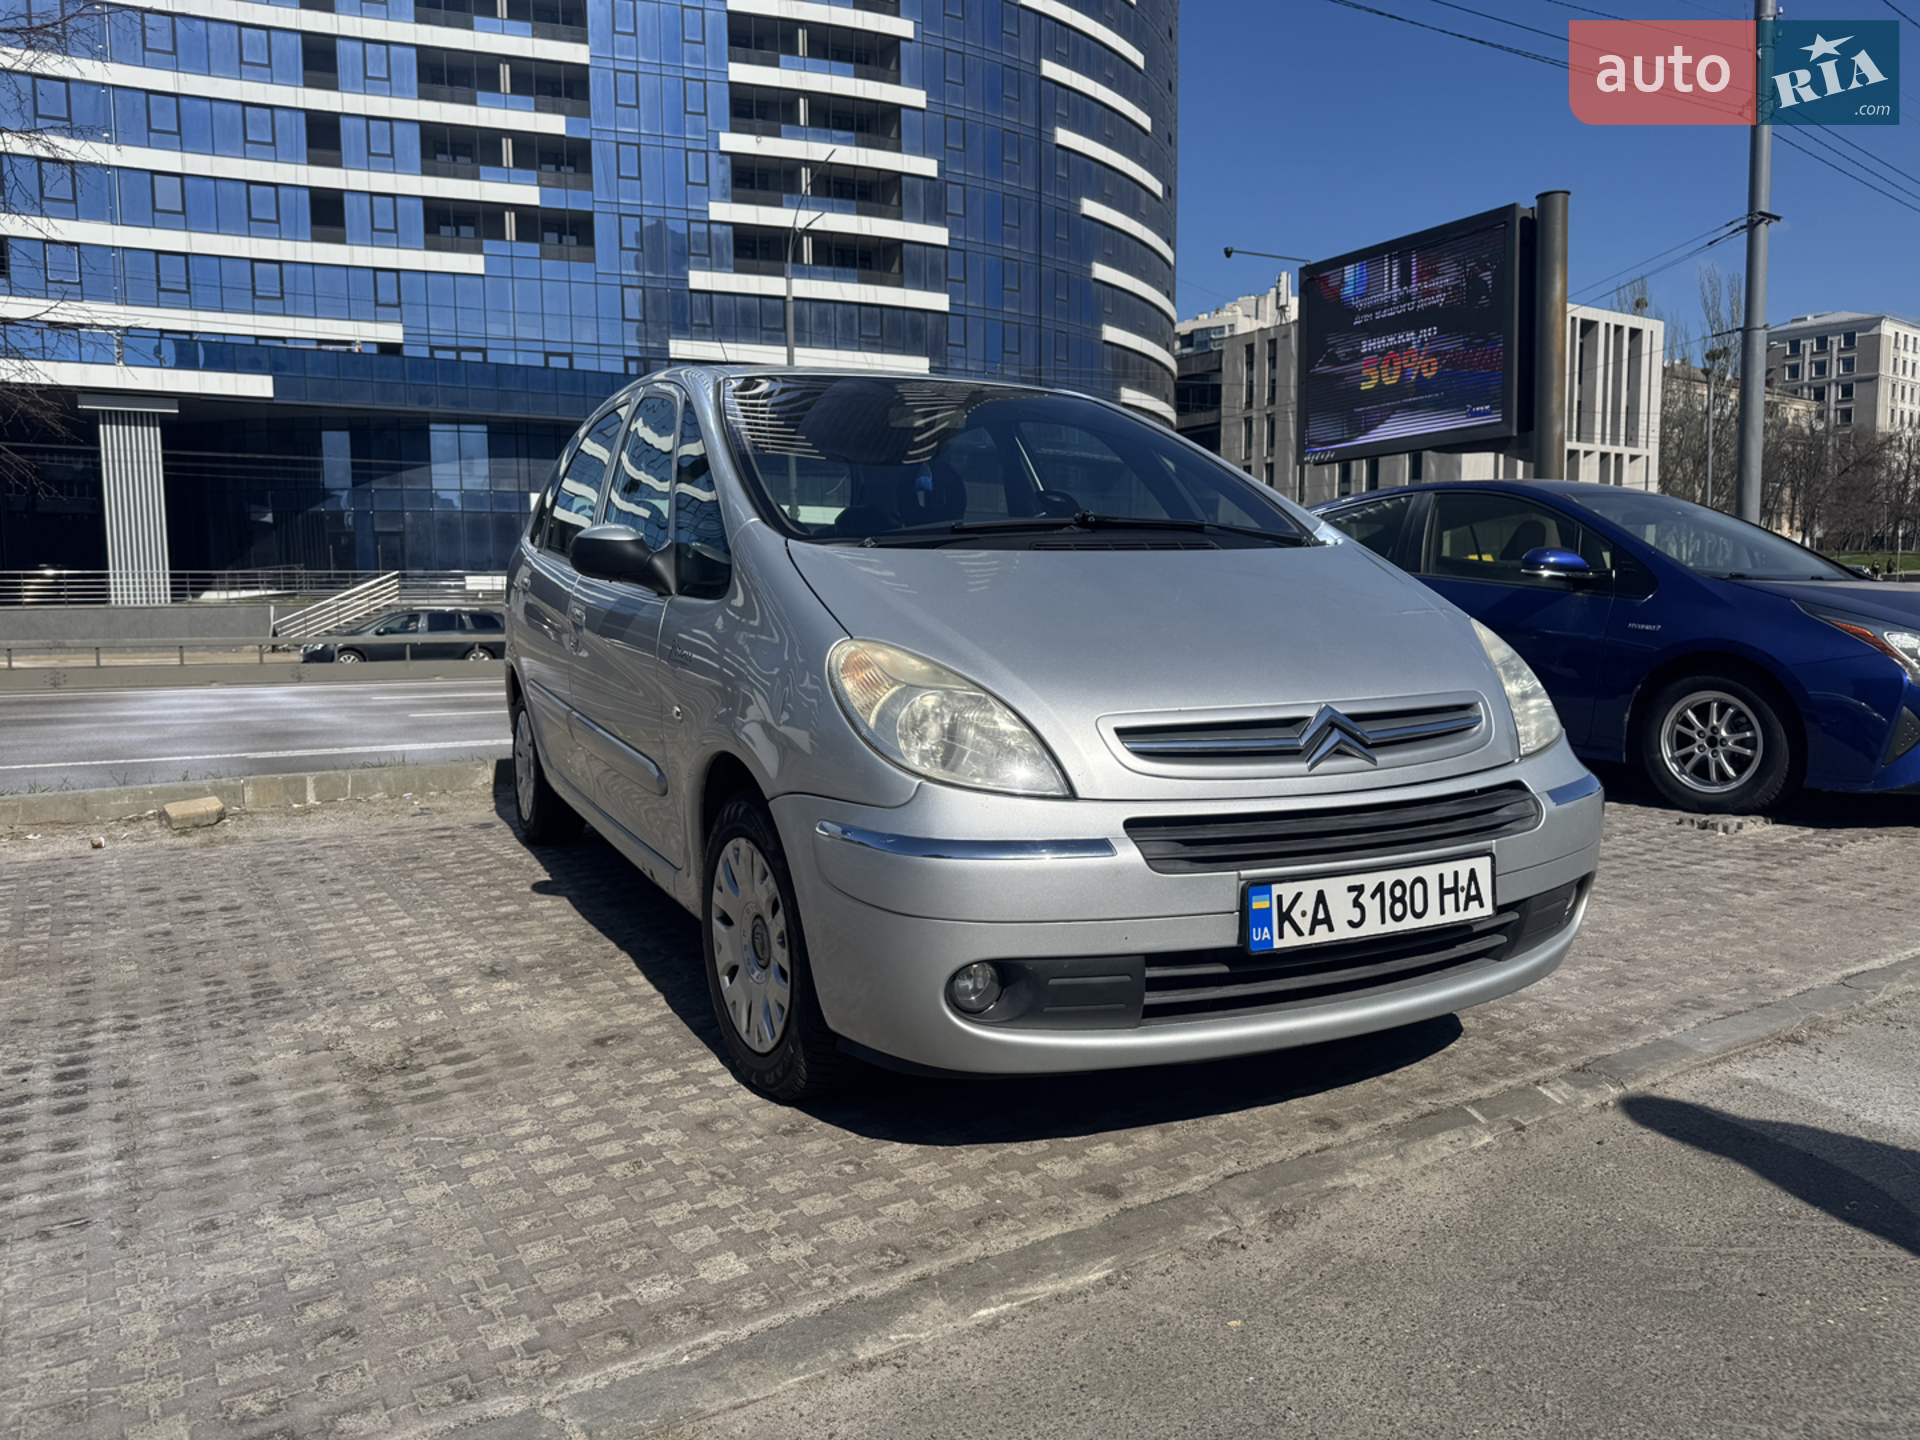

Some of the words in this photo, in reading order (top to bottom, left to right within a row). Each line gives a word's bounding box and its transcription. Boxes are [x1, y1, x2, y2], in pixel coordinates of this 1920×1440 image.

[1360, 348, 1438, 390] 50%
[1276, 889, 1335, 940] KA
[1347, 876, 1429, 929] 3180
[1439, 867, 1485, 915] HA
[1252, 926, 1271, 941] UA
